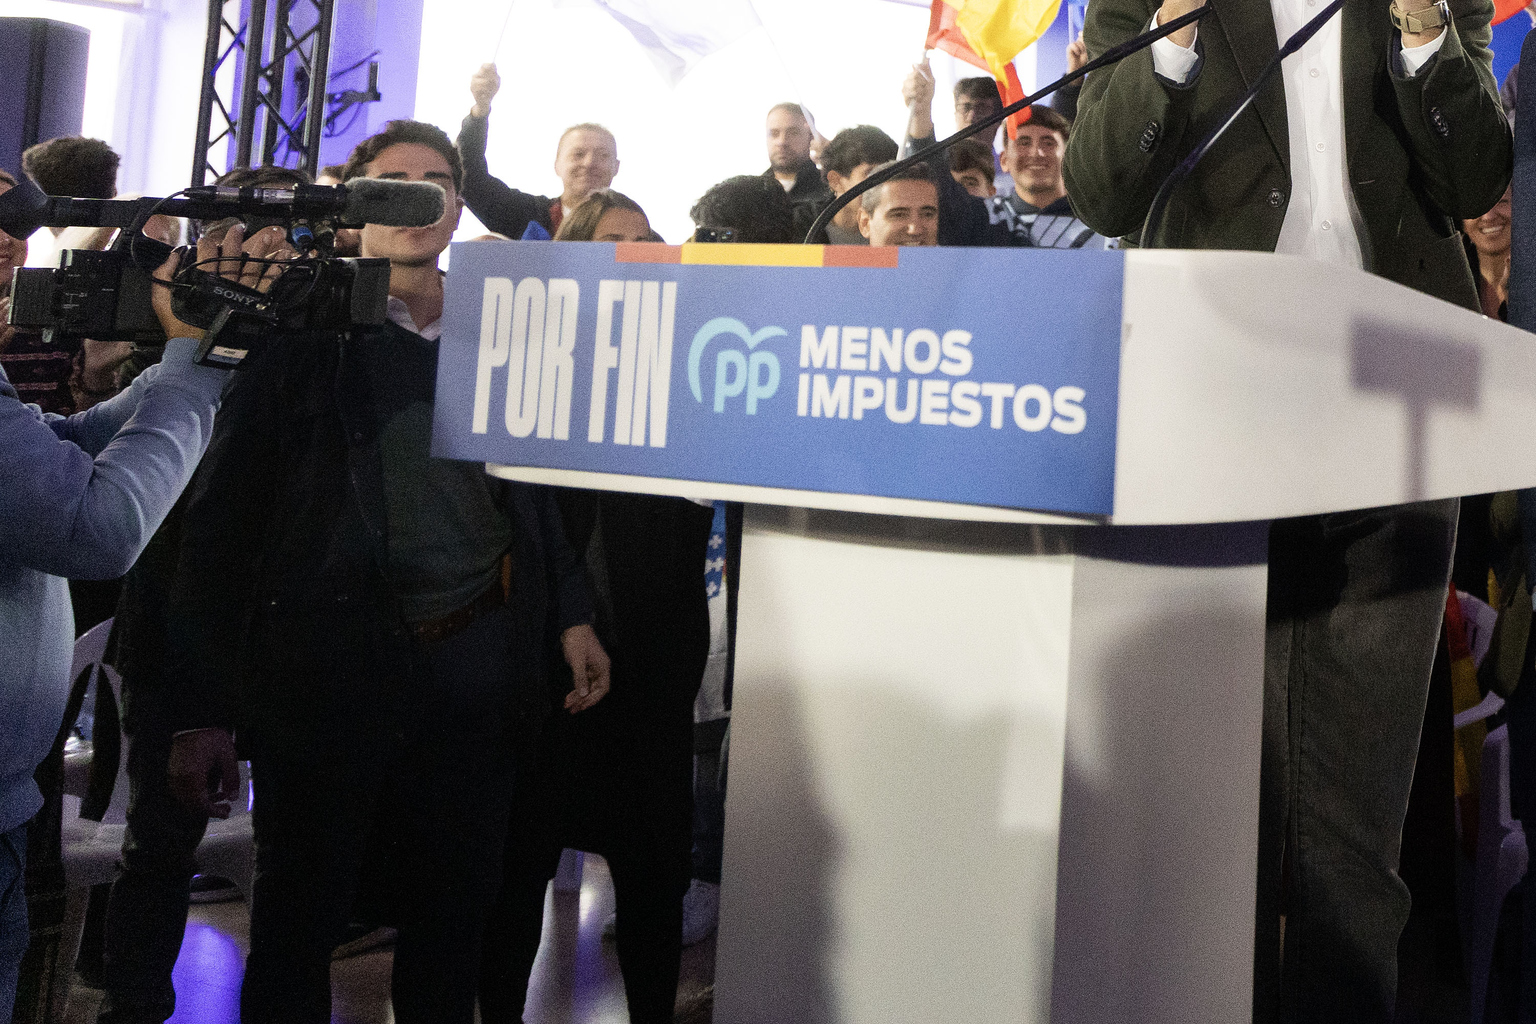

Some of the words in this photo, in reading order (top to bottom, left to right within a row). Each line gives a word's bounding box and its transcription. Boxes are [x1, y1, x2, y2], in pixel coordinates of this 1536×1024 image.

[213, 285, 255, 306] SONY
[471, 276, 580, 441] POR
[587, 279, 678, 449] FIN
[799, 324, 974, 377] MENOS
[796, 372, 1088, 435] IMPUESTOS
